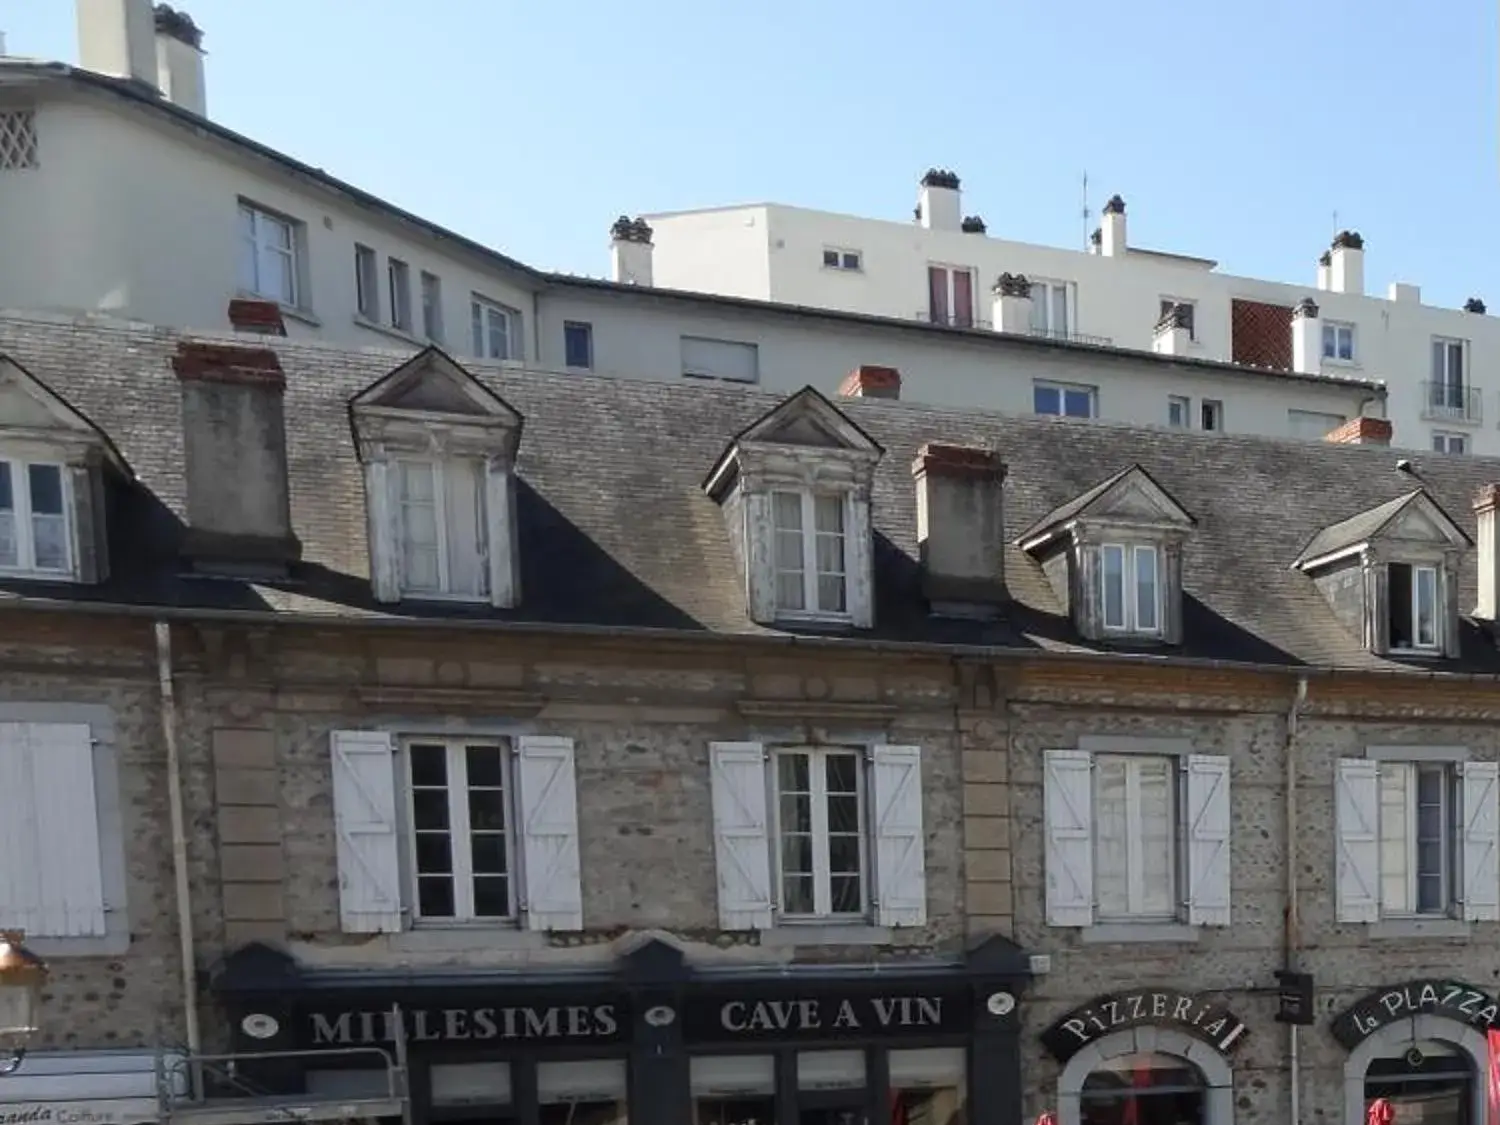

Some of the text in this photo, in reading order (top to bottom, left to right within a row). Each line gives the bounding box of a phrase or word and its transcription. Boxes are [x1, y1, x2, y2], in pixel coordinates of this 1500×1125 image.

[309, 1005, 618, 1044] MILLESIMES
[720, 997, 942, 1032] CAVE A VIN
